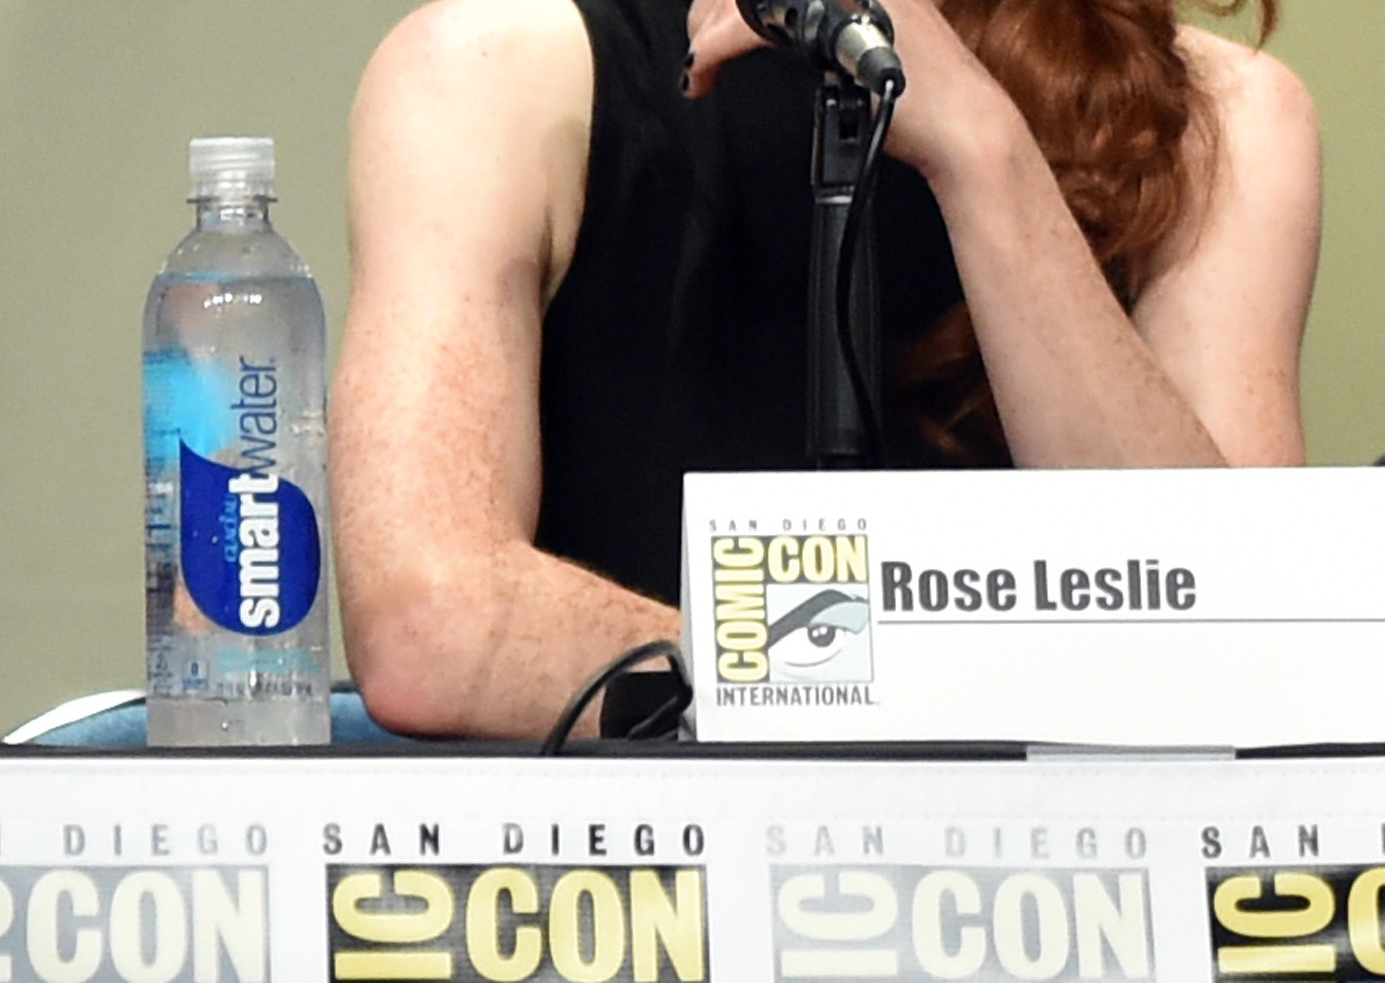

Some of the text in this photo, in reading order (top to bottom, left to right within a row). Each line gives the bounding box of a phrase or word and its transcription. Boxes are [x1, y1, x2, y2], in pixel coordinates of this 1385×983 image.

[709, 517, 867, 532] SAN DIEGO
[767, 534, 868, 583] CON
[880, 559, 1197, 613] Rose Leslie
[713, 535, 769, 682] COMIC
[716, 685, 876, 707] INTERNATIONAL
[64, 823, 267, 857] DIEGO
[322, 823, 706, 857] SAN DIEGO
[766, 824, 1148, 860] SAN DIEGO
[1200, 824, 1320, 860] SAN
[26, 870, 264, 983] CON
[466, 868, 705, 983] CON
[911, 870, 1150, 980] CON
